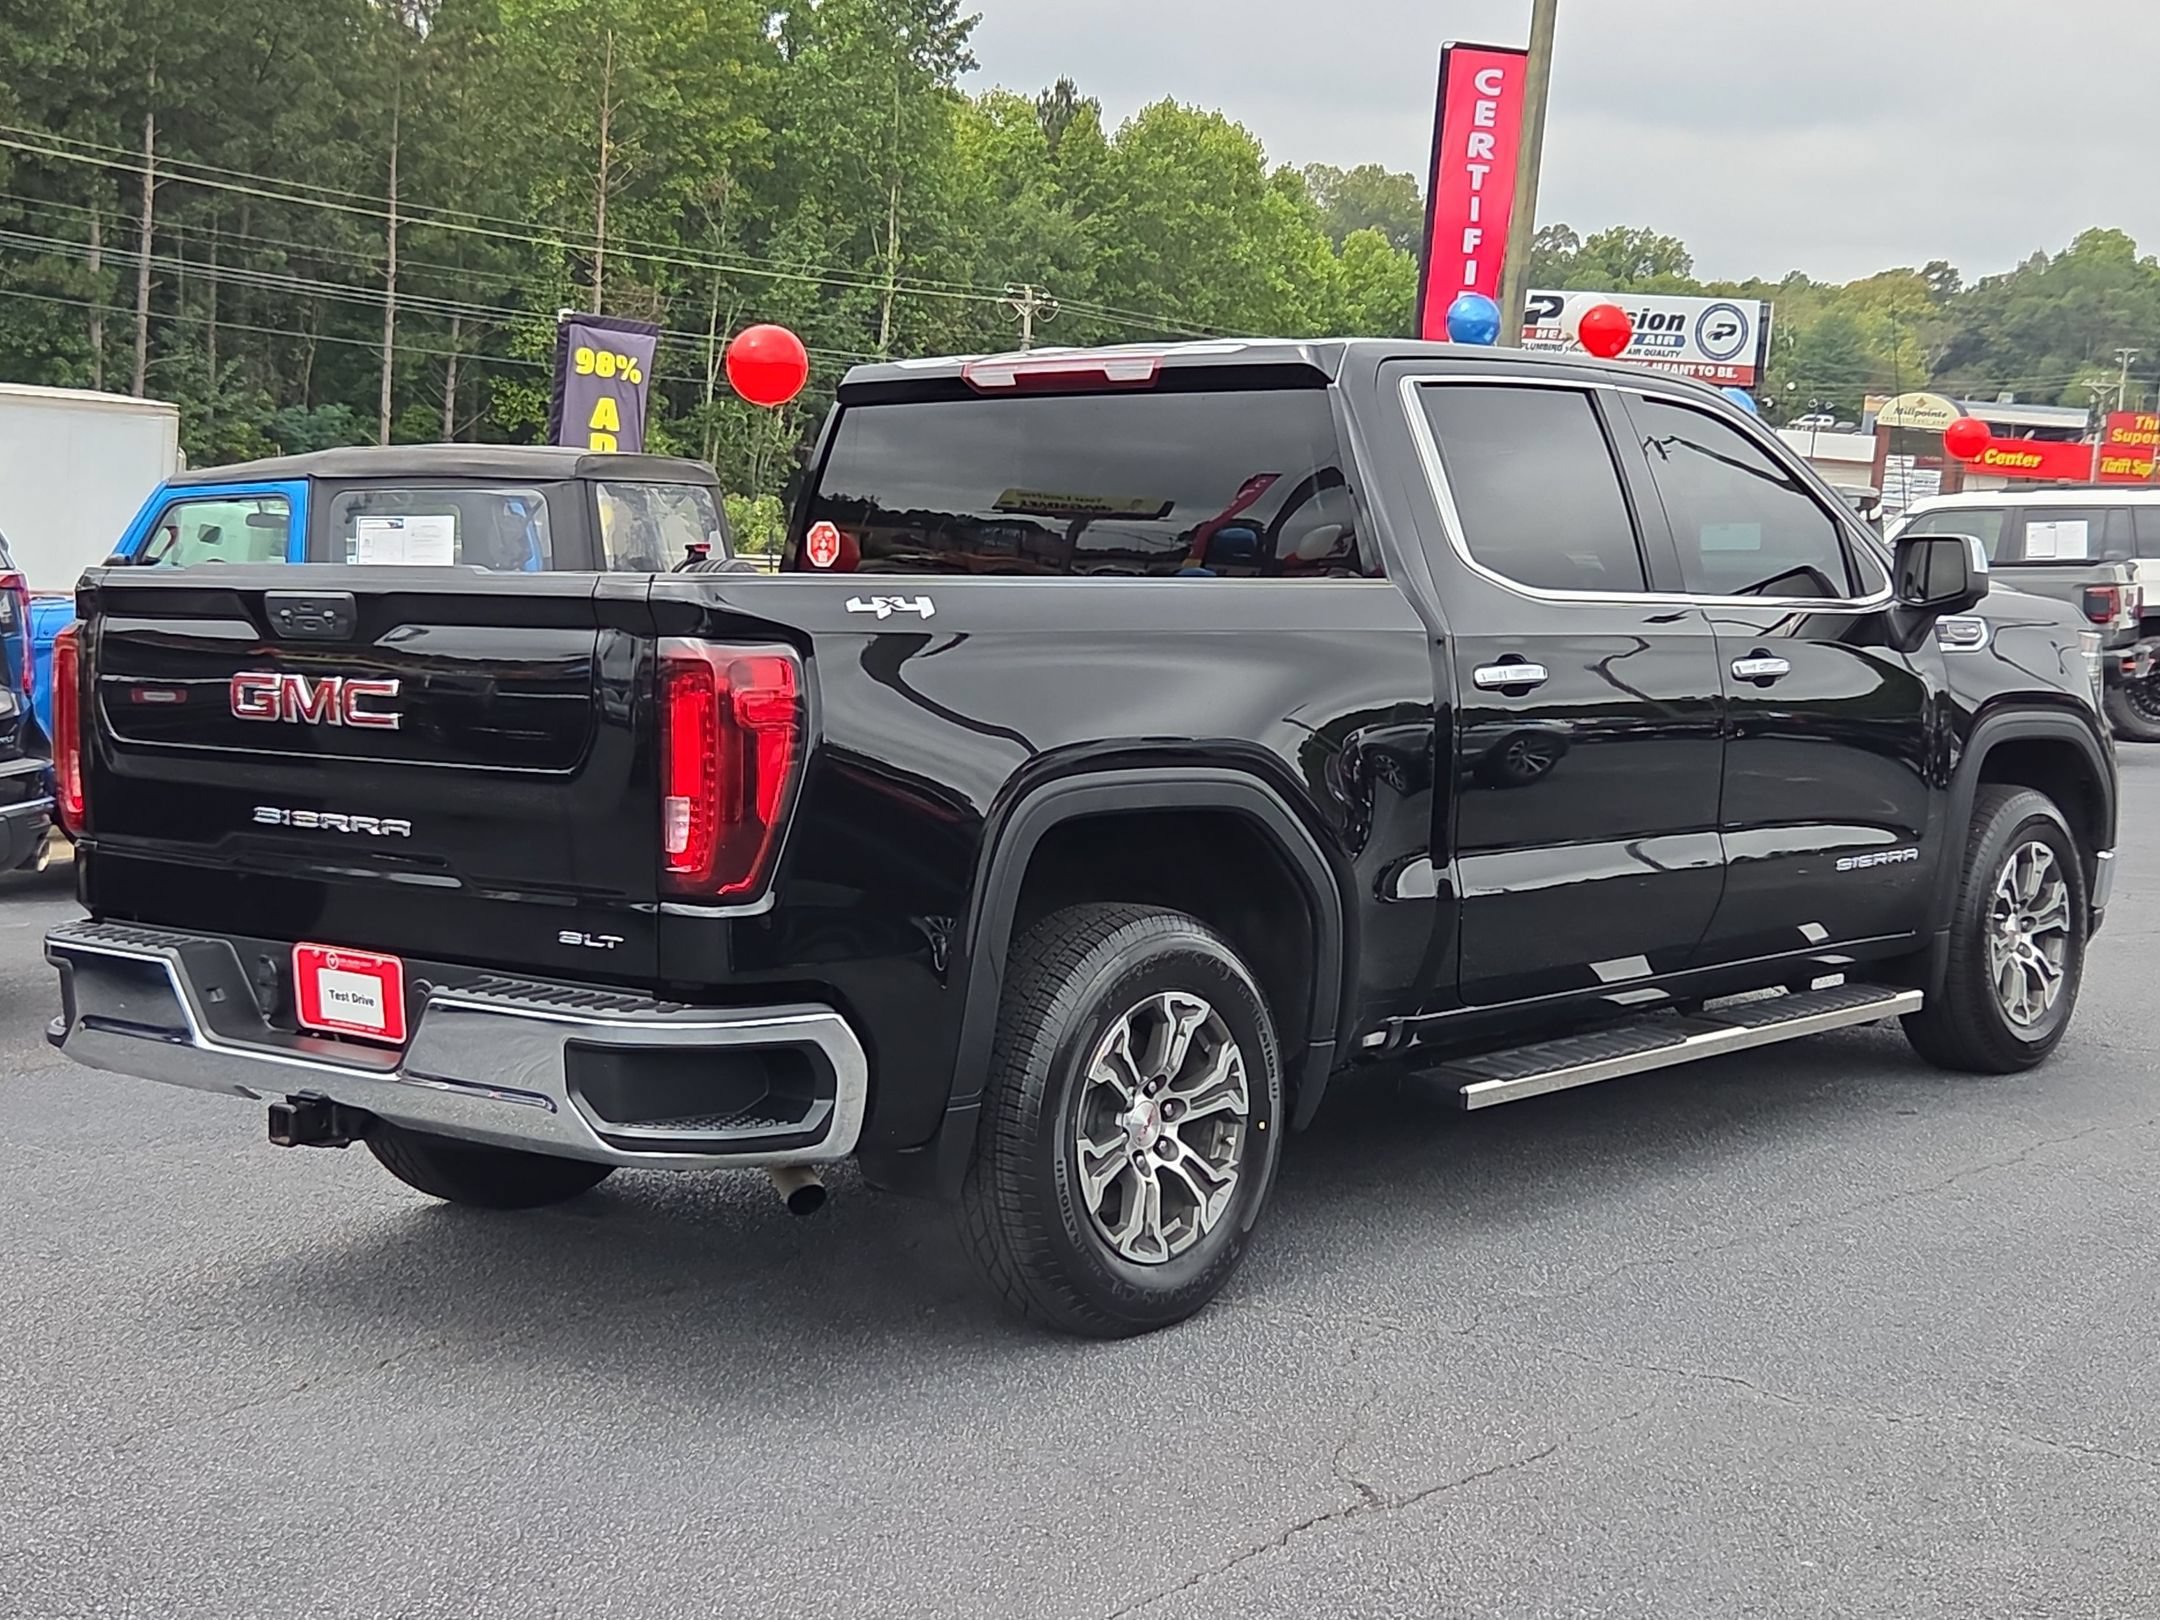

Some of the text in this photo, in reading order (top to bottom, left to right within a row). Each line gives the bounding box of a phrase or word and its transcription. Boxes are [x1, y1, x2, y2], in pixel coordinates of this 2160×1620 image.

[1458, 69, 1504, 298] CERTIFI
[1626, 308, 1686, 332] sion
[575, 347, 642, 384] 98%
[1984, 449, 2043, 467] Center
[230, 671, 402, 730] GMC
[252, 806, 412, 837] SIERRA
[1835, 848, 1919, 871] SIERRA
[558, 931, 624, 949] SLT
[328, 989, 375, 1007] Test Drive
